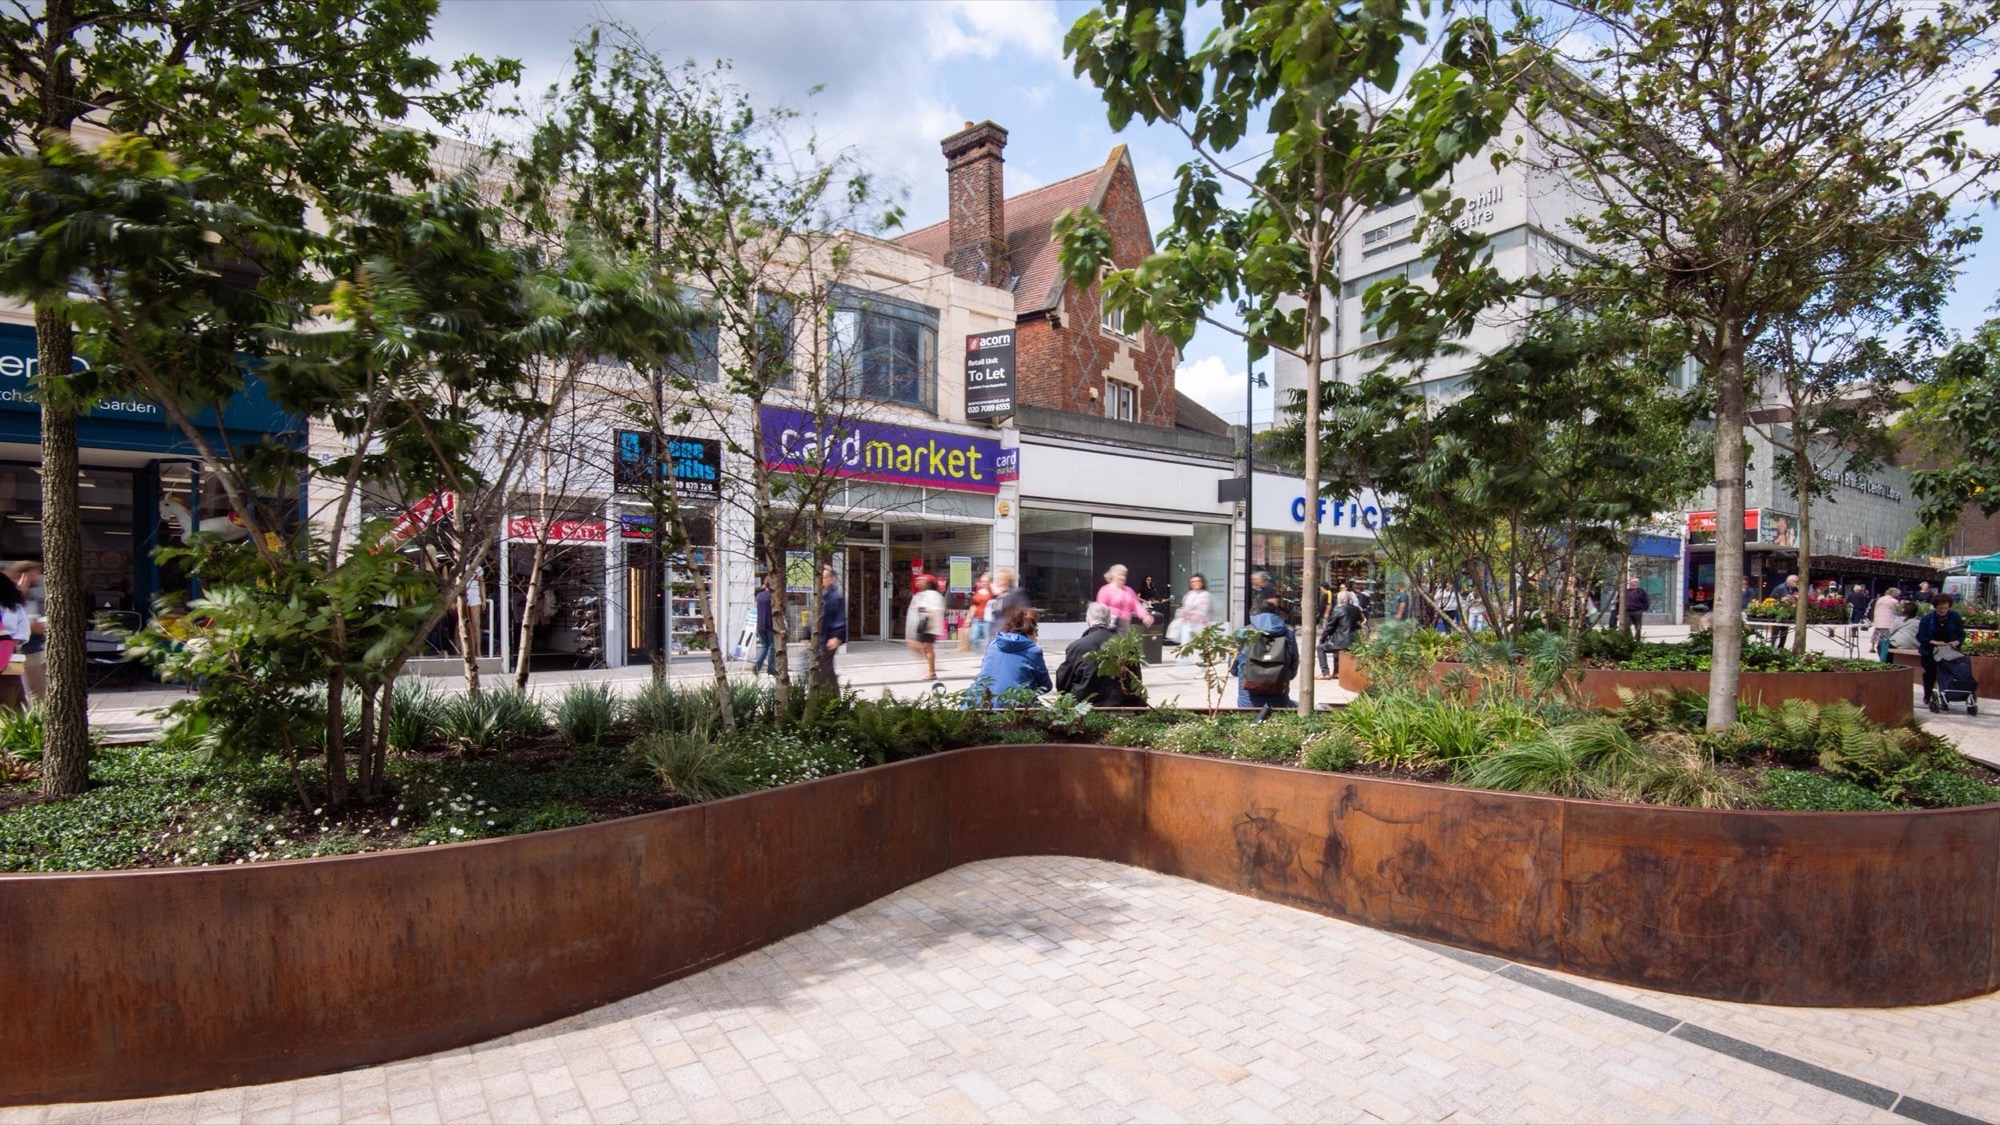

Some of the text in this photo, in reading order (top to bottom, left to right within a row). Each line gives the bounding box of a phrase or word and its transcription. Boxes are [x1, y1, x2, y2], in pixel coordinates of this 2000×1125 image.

[1428, 209, 1494, 235] Teatre
[980, 334, 1010, 347] acorn
[967, 357, 999, 367] Retail Unit
[968, 367, 1006, 382] To Let
[968, 402, 1011, 413] 020 7089 6555
[996, 452, 1017, 467] card
[996, 465, 1017, 475] market
[561, 522, 604, 542] SALE
